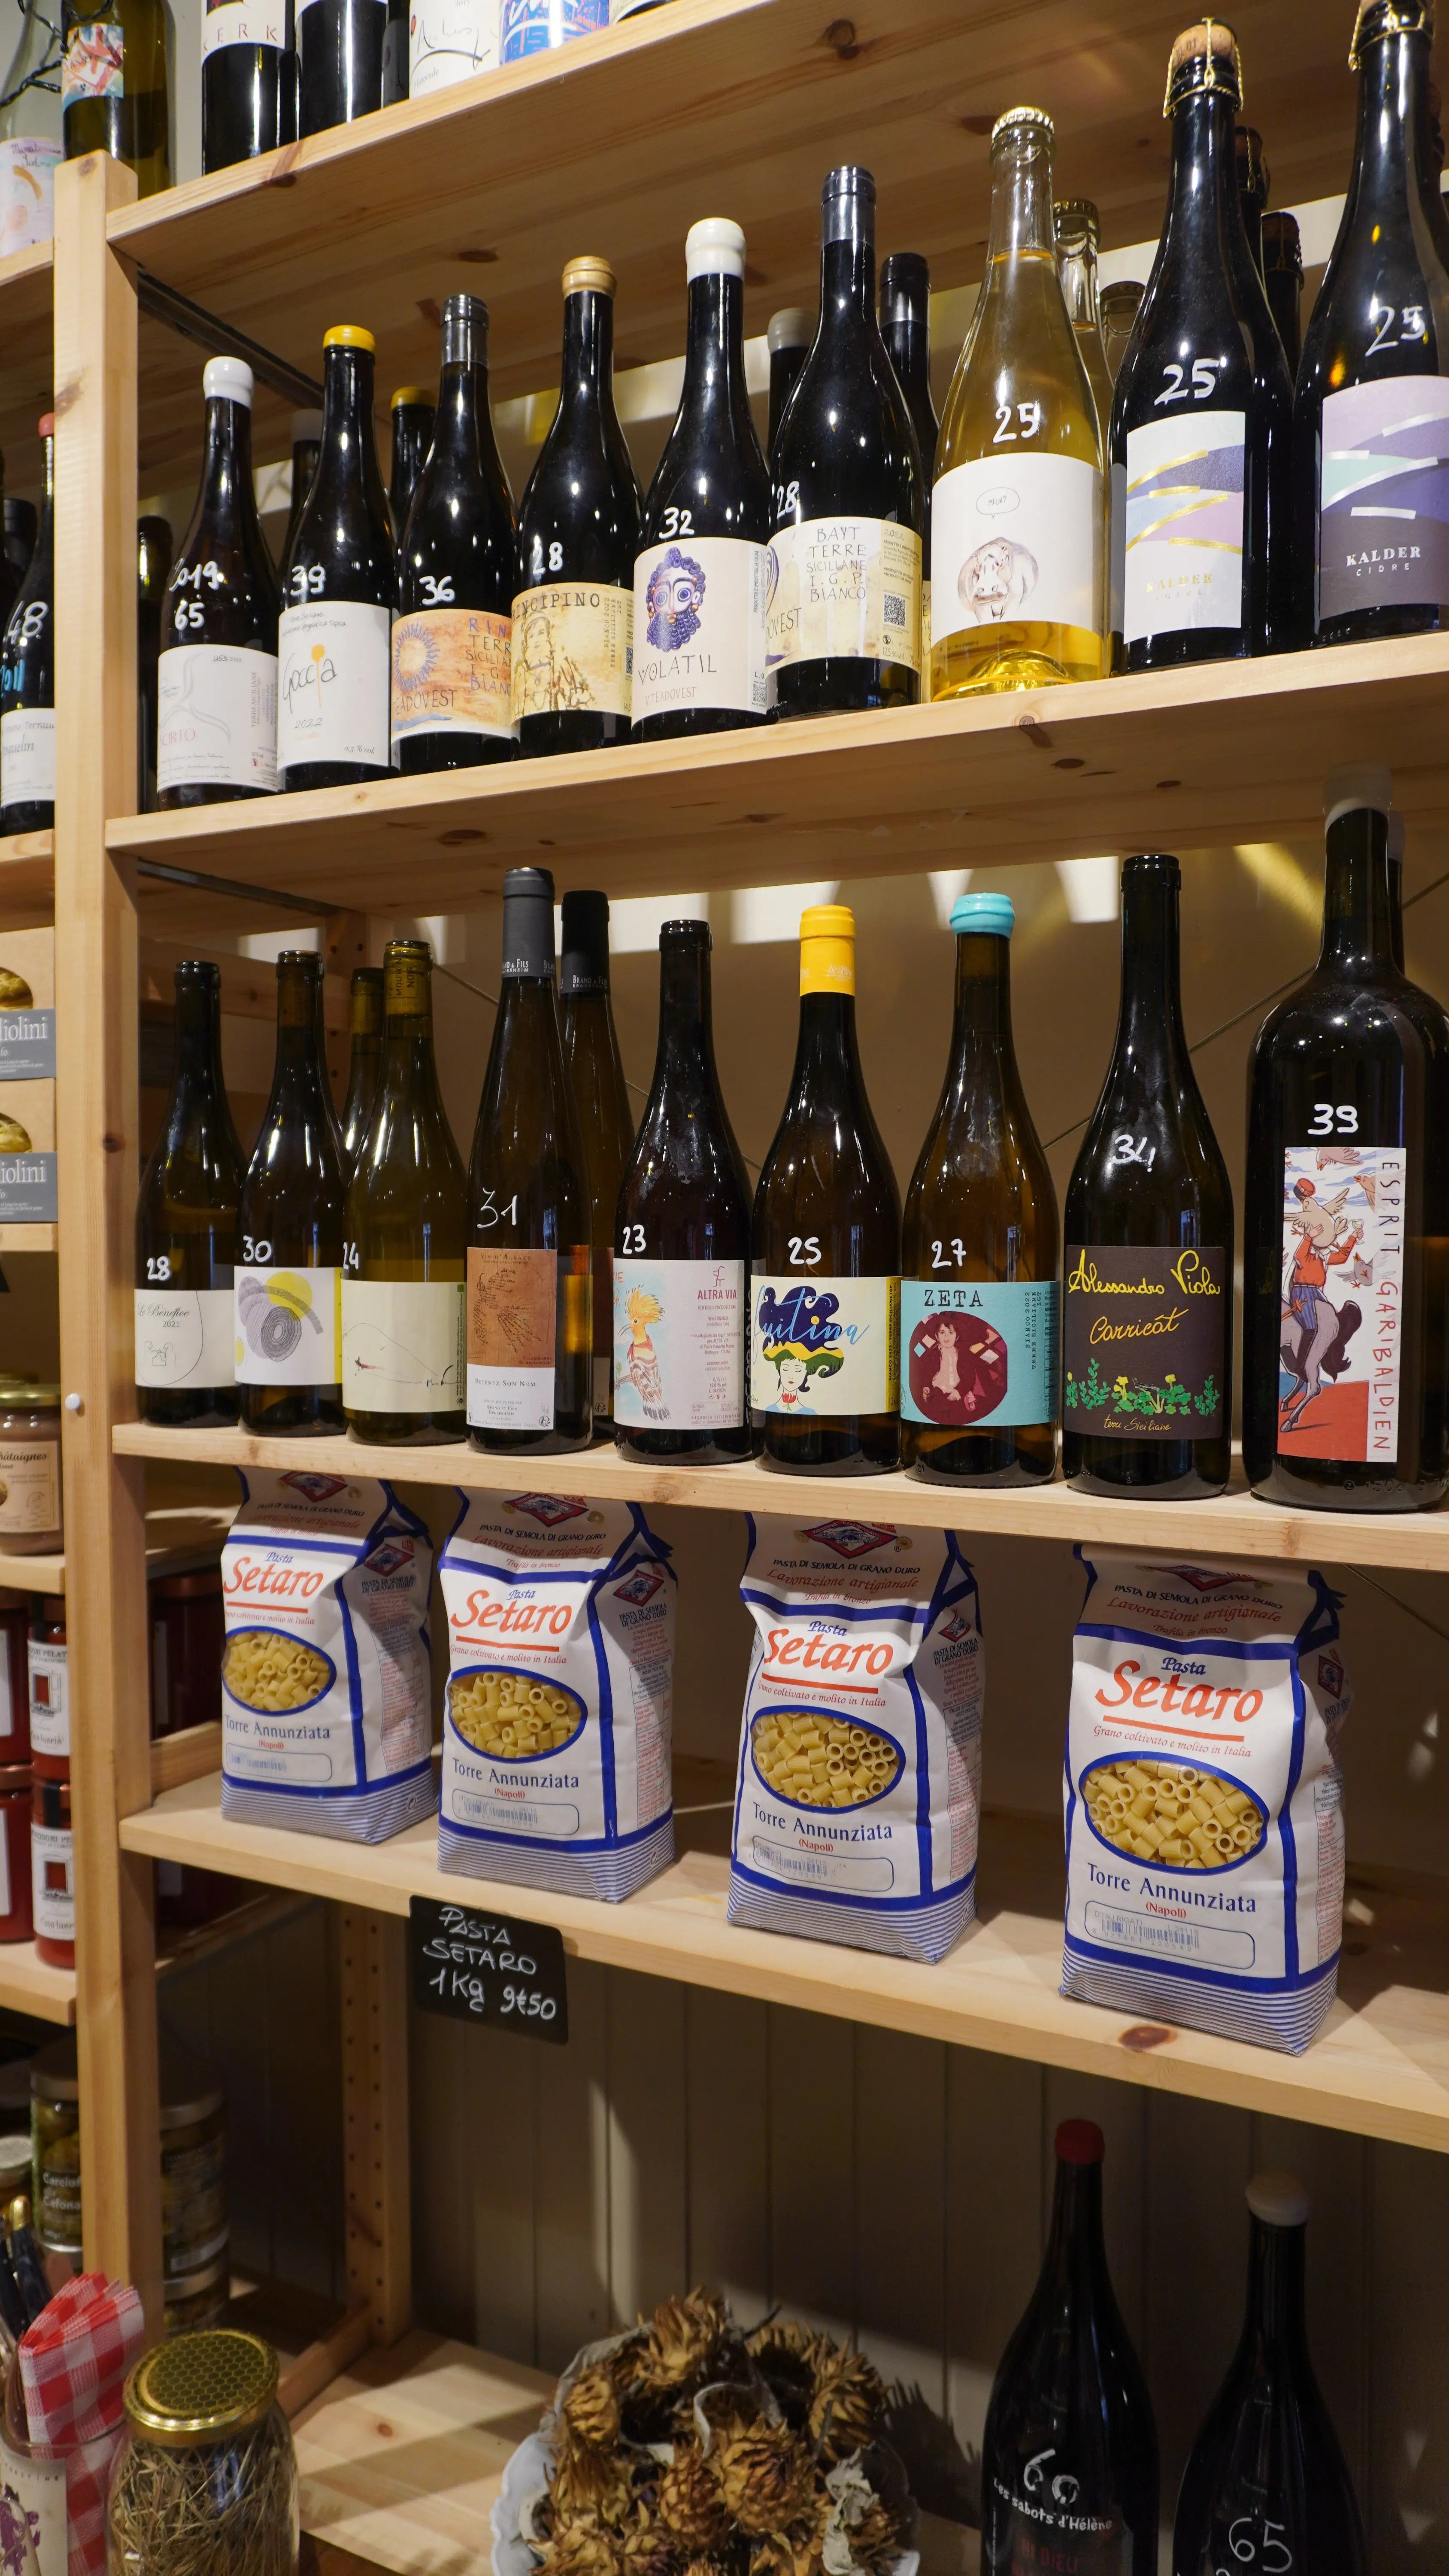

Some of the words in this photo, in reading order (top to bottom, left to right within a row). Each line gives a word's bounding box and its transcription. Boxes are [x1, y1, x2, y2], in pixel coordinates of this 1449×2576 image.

[1365, 306, 1425, 357] 25
[1155, 358, 1219, 405] 25
[993, 403, 1040, 444] 25
[776, 481, 799, 519] 28
[658, 507, 694, 539] 32
[817, 526, 860, 542] BAYT
[531, 542, 563, 574] 28
[809, 544, 866, 558] TERRE
[1346, 547, 1421, 567] KALDER
[291, 563, 326, 596] 39
[1356, 563, 1410, 576] CIDRE
[419, 576, 455, 604] 36
[811, 587, 866, 602] BIANCO
[9, 600, 49, 644] 48
[175, 600, 205, 630] 65
[638, 655, 717, 685] VOLATIL
[645, 687, 697, 706] VITEADOVEST
[294, 718, 323, 729] 2022
[517, 959, 529, 968] FILS
[573, 975, 591, 984] BRAND
[1308, 1103, 1360, 1135] 39
[1113, 1133, 1156, 1173] 34
[477, 1188, 518, 1228] 31
[1379, 1161, 1400, 1255] ESPRIT
[243, 1235, 273, 1262] 30
[623, 1224, 646, 1254] 23
[788, 1237, 822, 1265] 25
[931, 1239, 967, 1269] 27
[147, 1255, 170, 1281] 28
[1068, 1249, 1165, 1296] Alessandro
[1171, 1250, 1221, 1296] Viola
[698, 1290, 723, 1300] ALTRA
[725, 1290, 737, 1300] VIA
[925, 1289, 984, 1307] ZETA
[1373, 1281, 1399, 1450] GARIBALDIEN
[475, 1378, 500, 1386] RETENEZ
[480, 1525, 502, 1533] PASTA
[515, 1531, 546, 1541] SEMOLA
[264, 1552, 293, 1564] Pasta
[773, 1559, 797, 1567] PASTA
[860, 1564, 892, 1574] GRANO
[224, 1556, 324, 1598] Setaro
[766, 1569, 844, 1586] Lavorazione
[849, 1577, 918, 1593] artigianale
[506, 1589, 535, 1600] Pasta
[805, 1592, 830, 1602] Trafila
[843, 1594, 871, 1604] bronzo
[1114, 1585, 1142, 1597] PASTA
[1146, 1590, 1157, 1599] DI
[1159, 1592, 1198, 1605] SEMOLA
[1202, 1595, 1211, 1604] DI
[1213, 1594, 1249, 1602] GRANO
[1252, 1597, 1283, 1610] DURO
[450, 1589, 572, 1634] Setaro
[1107, 1597, 1199, 1622] Lavorazione
[1203, 1605, 1281, 1622] artigianale
[807, 1621, 847, 1637] Pasta
[1198, 1625, 1228, 1635] bronzo
[450, 1646, 469, 1655] Grano
[470, 1649, 499, 1660] coltivato
[506, 1654, 530, 1663] molito
[544, 1656, 567, 1664] Italia
[764, 1628, 894, 1675] Setaro
[1161, 1657, 1206, 1675] Pasta
[774, 1687, 810, 1700] coltivato
[818, 1694, 846, 1704] molito
[849, 1696, 858, 1705] in
[860, 1697, 886, 1707] Italia
[1095, 1660, 1263, 1722] Setaro
[225, 1714, 249, 1733] Torre
[254, 1721, 330, 1739] Annunziata
[1094, 1725, 1122, 1738] Grano
[1125, 1731, 1167, 1747] coltivato
[1177, 1741, 1209, 1754] molito
[1212, 1744, 1221, 1754] in
[1223, 1746, 1252, 1757] Italia
[452, 1758, 482, 1780] Torre
[489, 1769, 579, 1788] Annunziata
[494, 1788, 525, 1799] (Napoli)
[753, 1802, 785, 1829] Torre
[793, 1818, 892, 1841] Annunziata
[798, 1838, 834, 1853] (Napoli)
[1087, 1862, 1131, 1892] Torre
[1140, 1878, 1256, 1913] Annunziata
[1117, 1916, 1142, 1926] RIGATI
[1146, 1901, 1187, 1919] (Napoli)
[439, 1906, 511, 1945] PASTA
[1175, 1926, 1199, 1936] 24115
[423, 1939, 537, 1975] SETARO
[500, 1986, 557, 2020] 9€50
[994, 2477, 1009, 2501] Les
[1012, 2497, 1054, 2525] sabots
[1058, 2515, 1113, 2532] d'Hélène
[1229, 2517, 1293, 2573] 65
